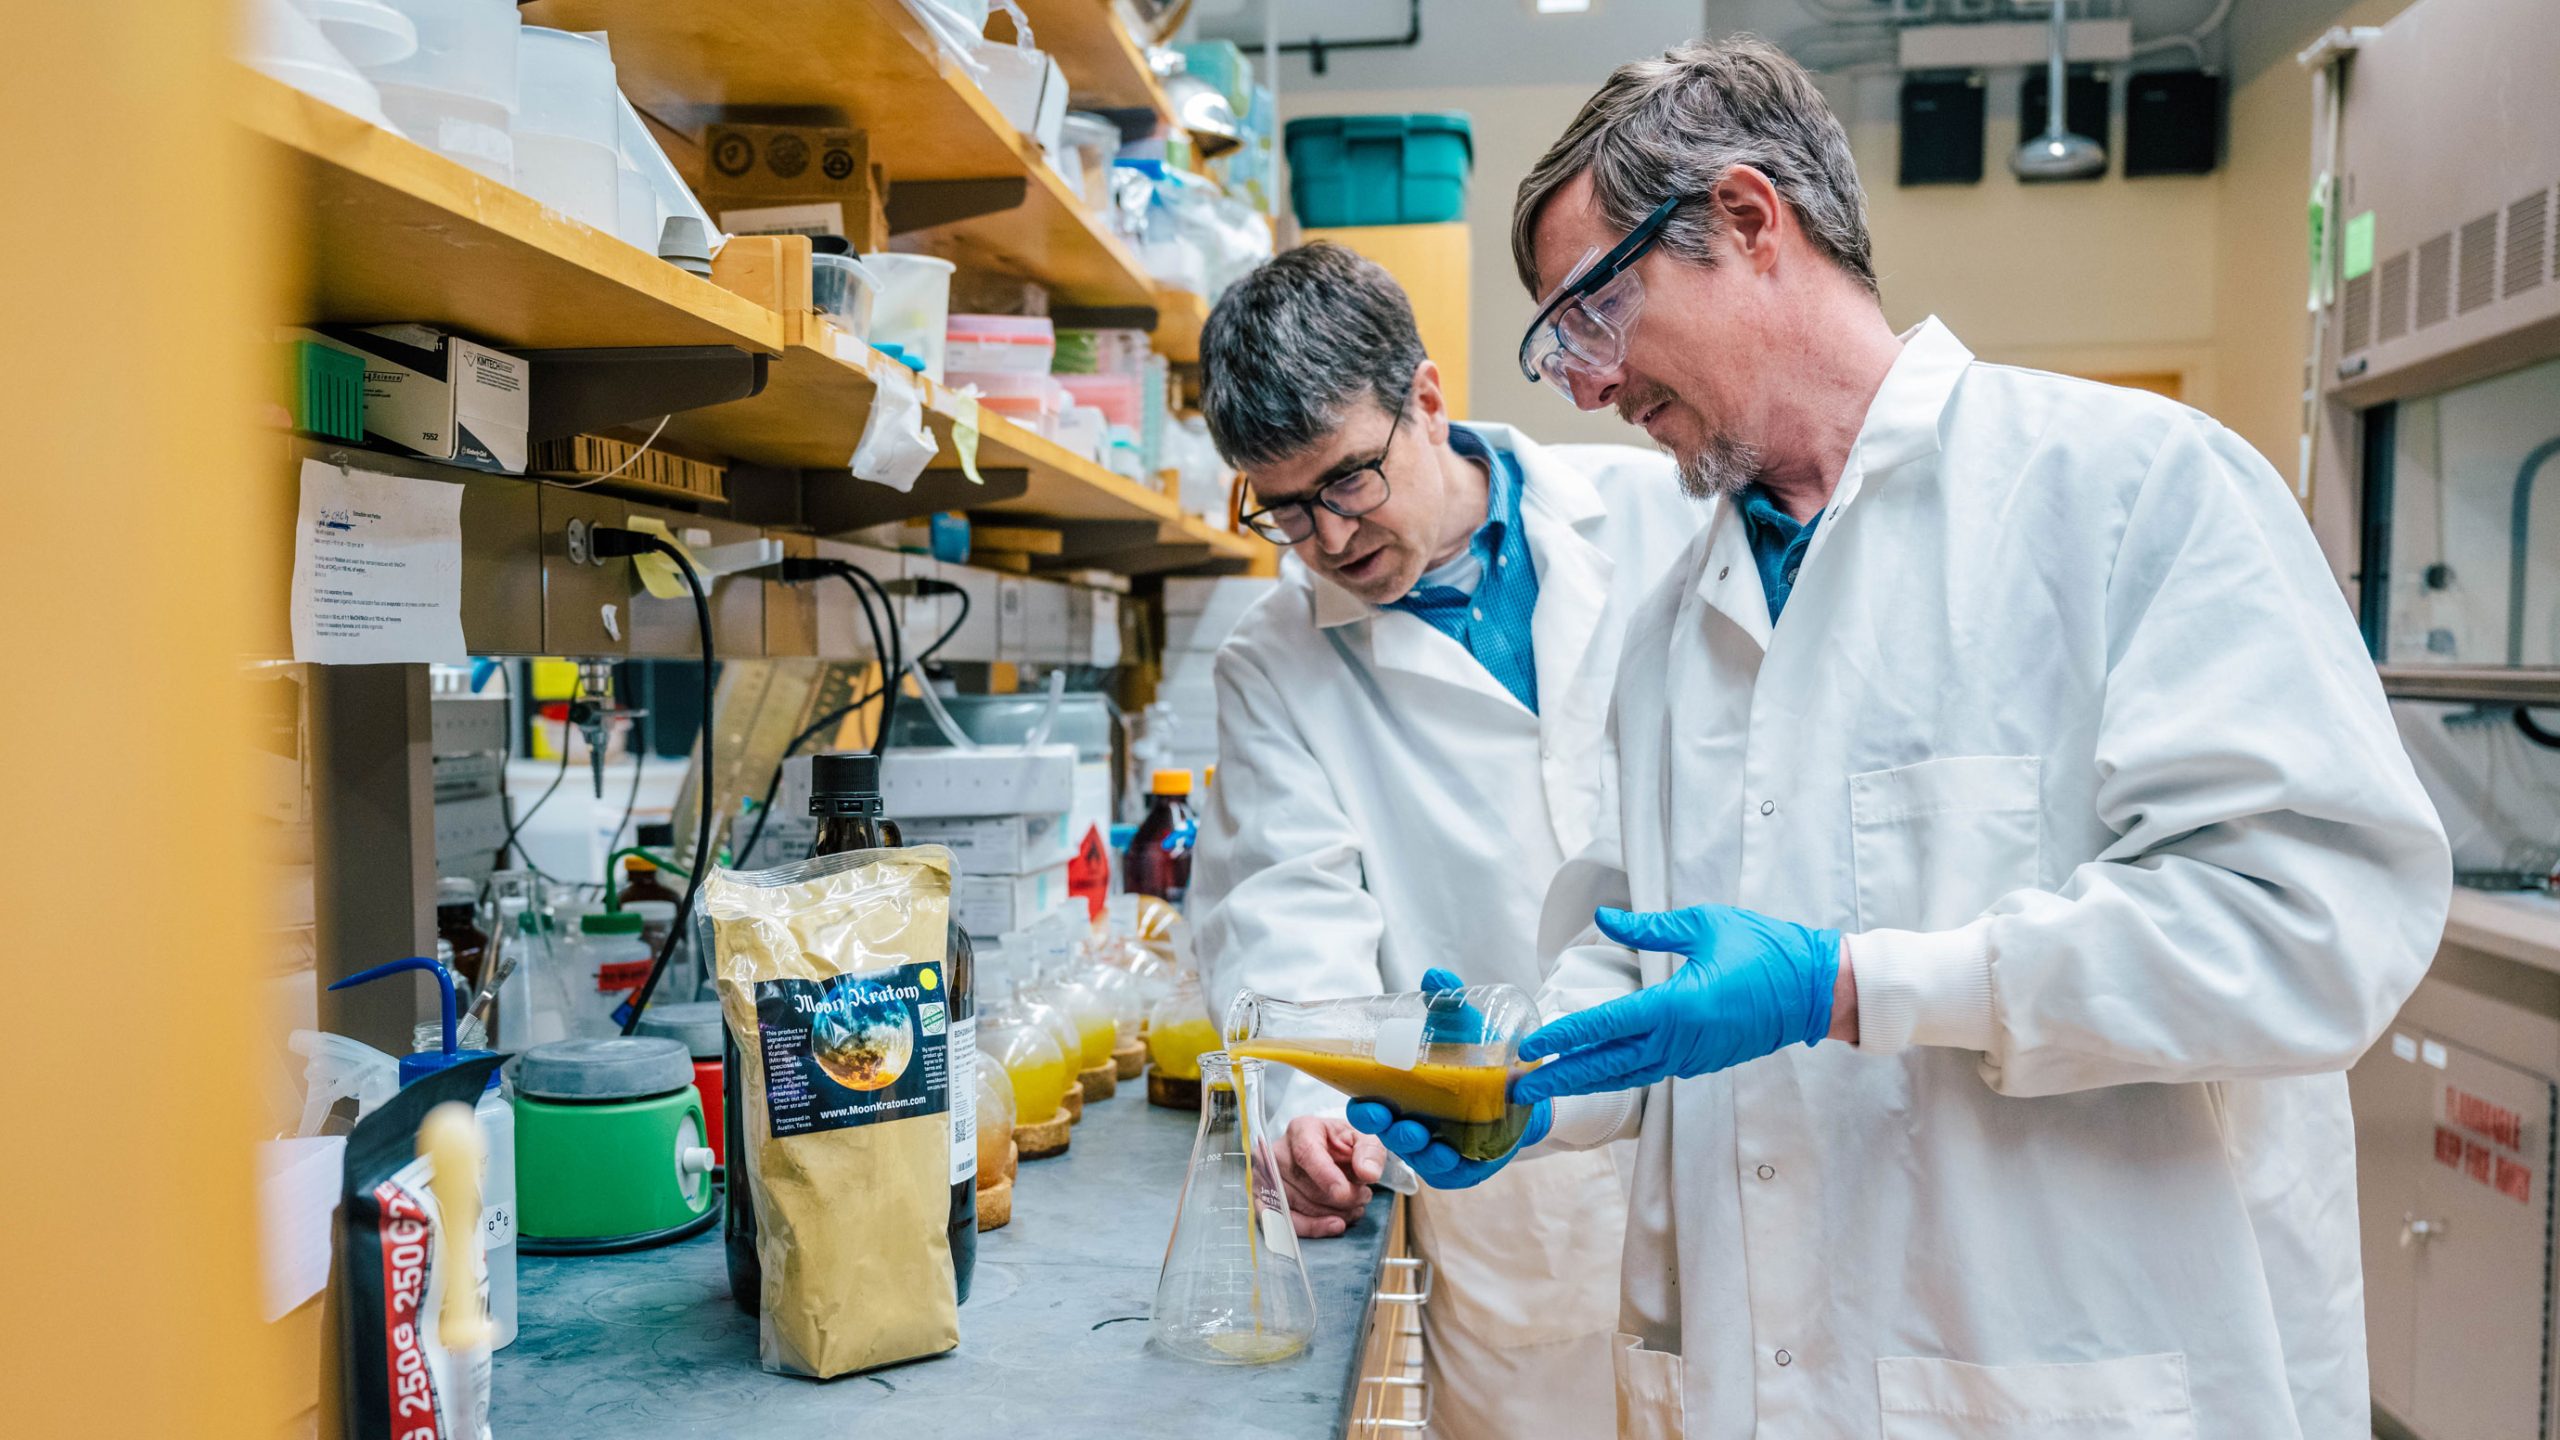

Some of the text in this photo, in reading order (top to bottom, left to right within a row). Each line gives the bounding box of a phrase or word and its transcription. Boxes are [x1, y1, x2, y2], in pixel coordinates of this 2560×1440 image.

[422, 433, 439, 441] 7552
[793, 984, 919, 1014] Moon Kratom
[778, 1028, 798, 1036] product
[820, 1096, 926, 1119] www.MoonKratom.com
[776, 1115, 804, 1124] Processed
[497, 1211, 501, 1221] 0
[489, 1221, 494, 1231] 0
[388, 1219, 424, 1313] 250G
[393, 1322, 431, 1418] 250G
